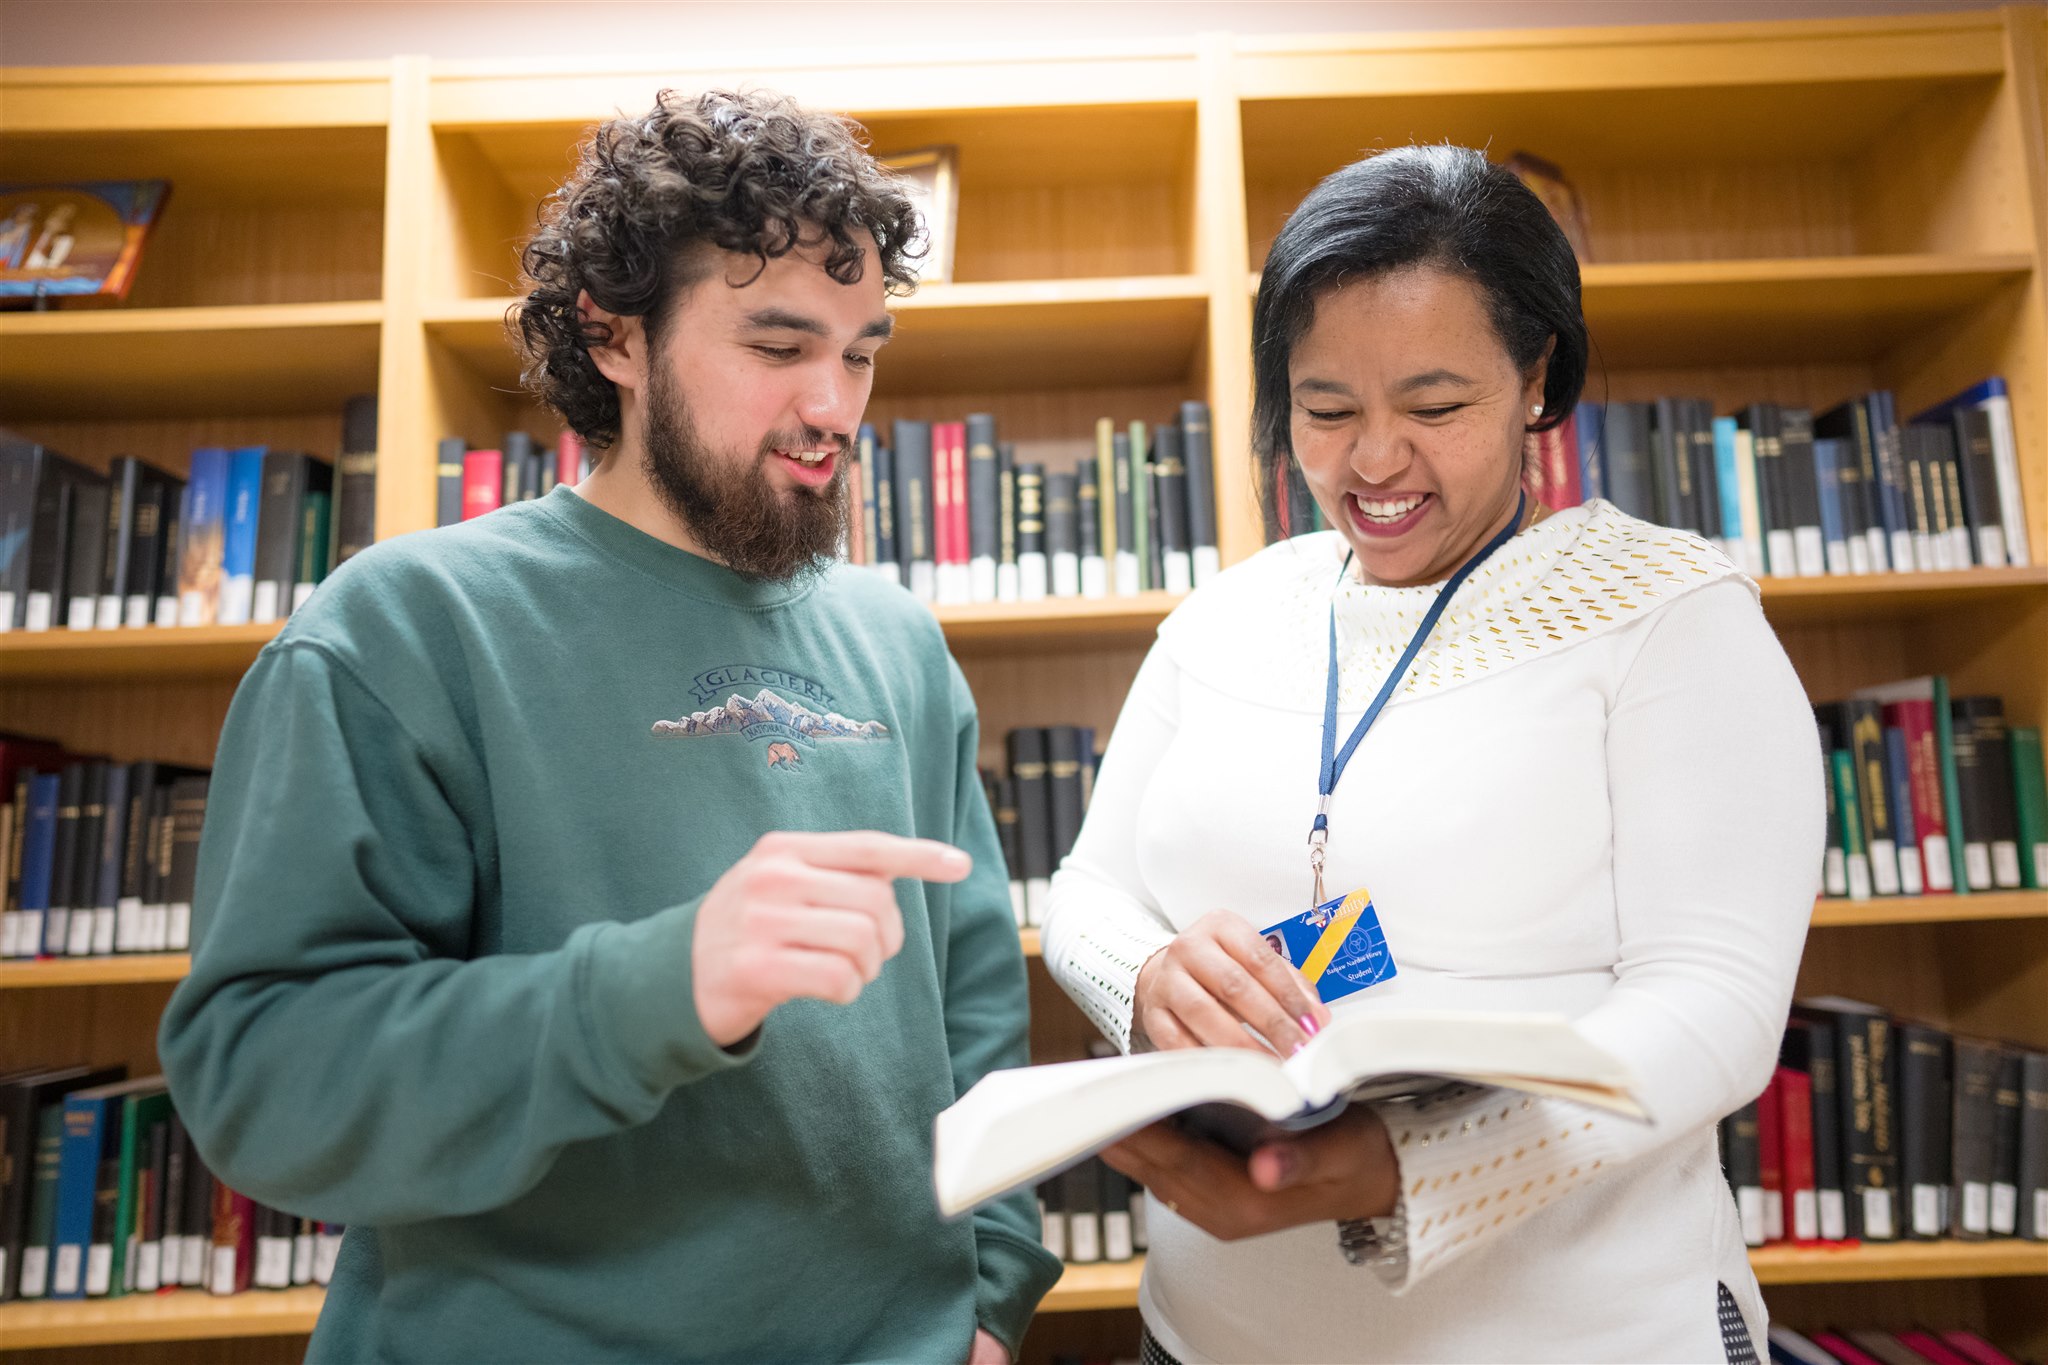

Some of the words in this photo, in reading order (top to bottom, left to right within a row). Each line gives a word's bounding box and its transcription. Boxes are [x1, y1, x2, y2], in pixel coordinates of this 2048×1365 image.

[706, 668, 817, 698] GLACIER
[747, 724, 785, 738] NATIONAL
[1325, 897, 1366, 920] Trinity
[1348, 967, 1372, 981] Student
